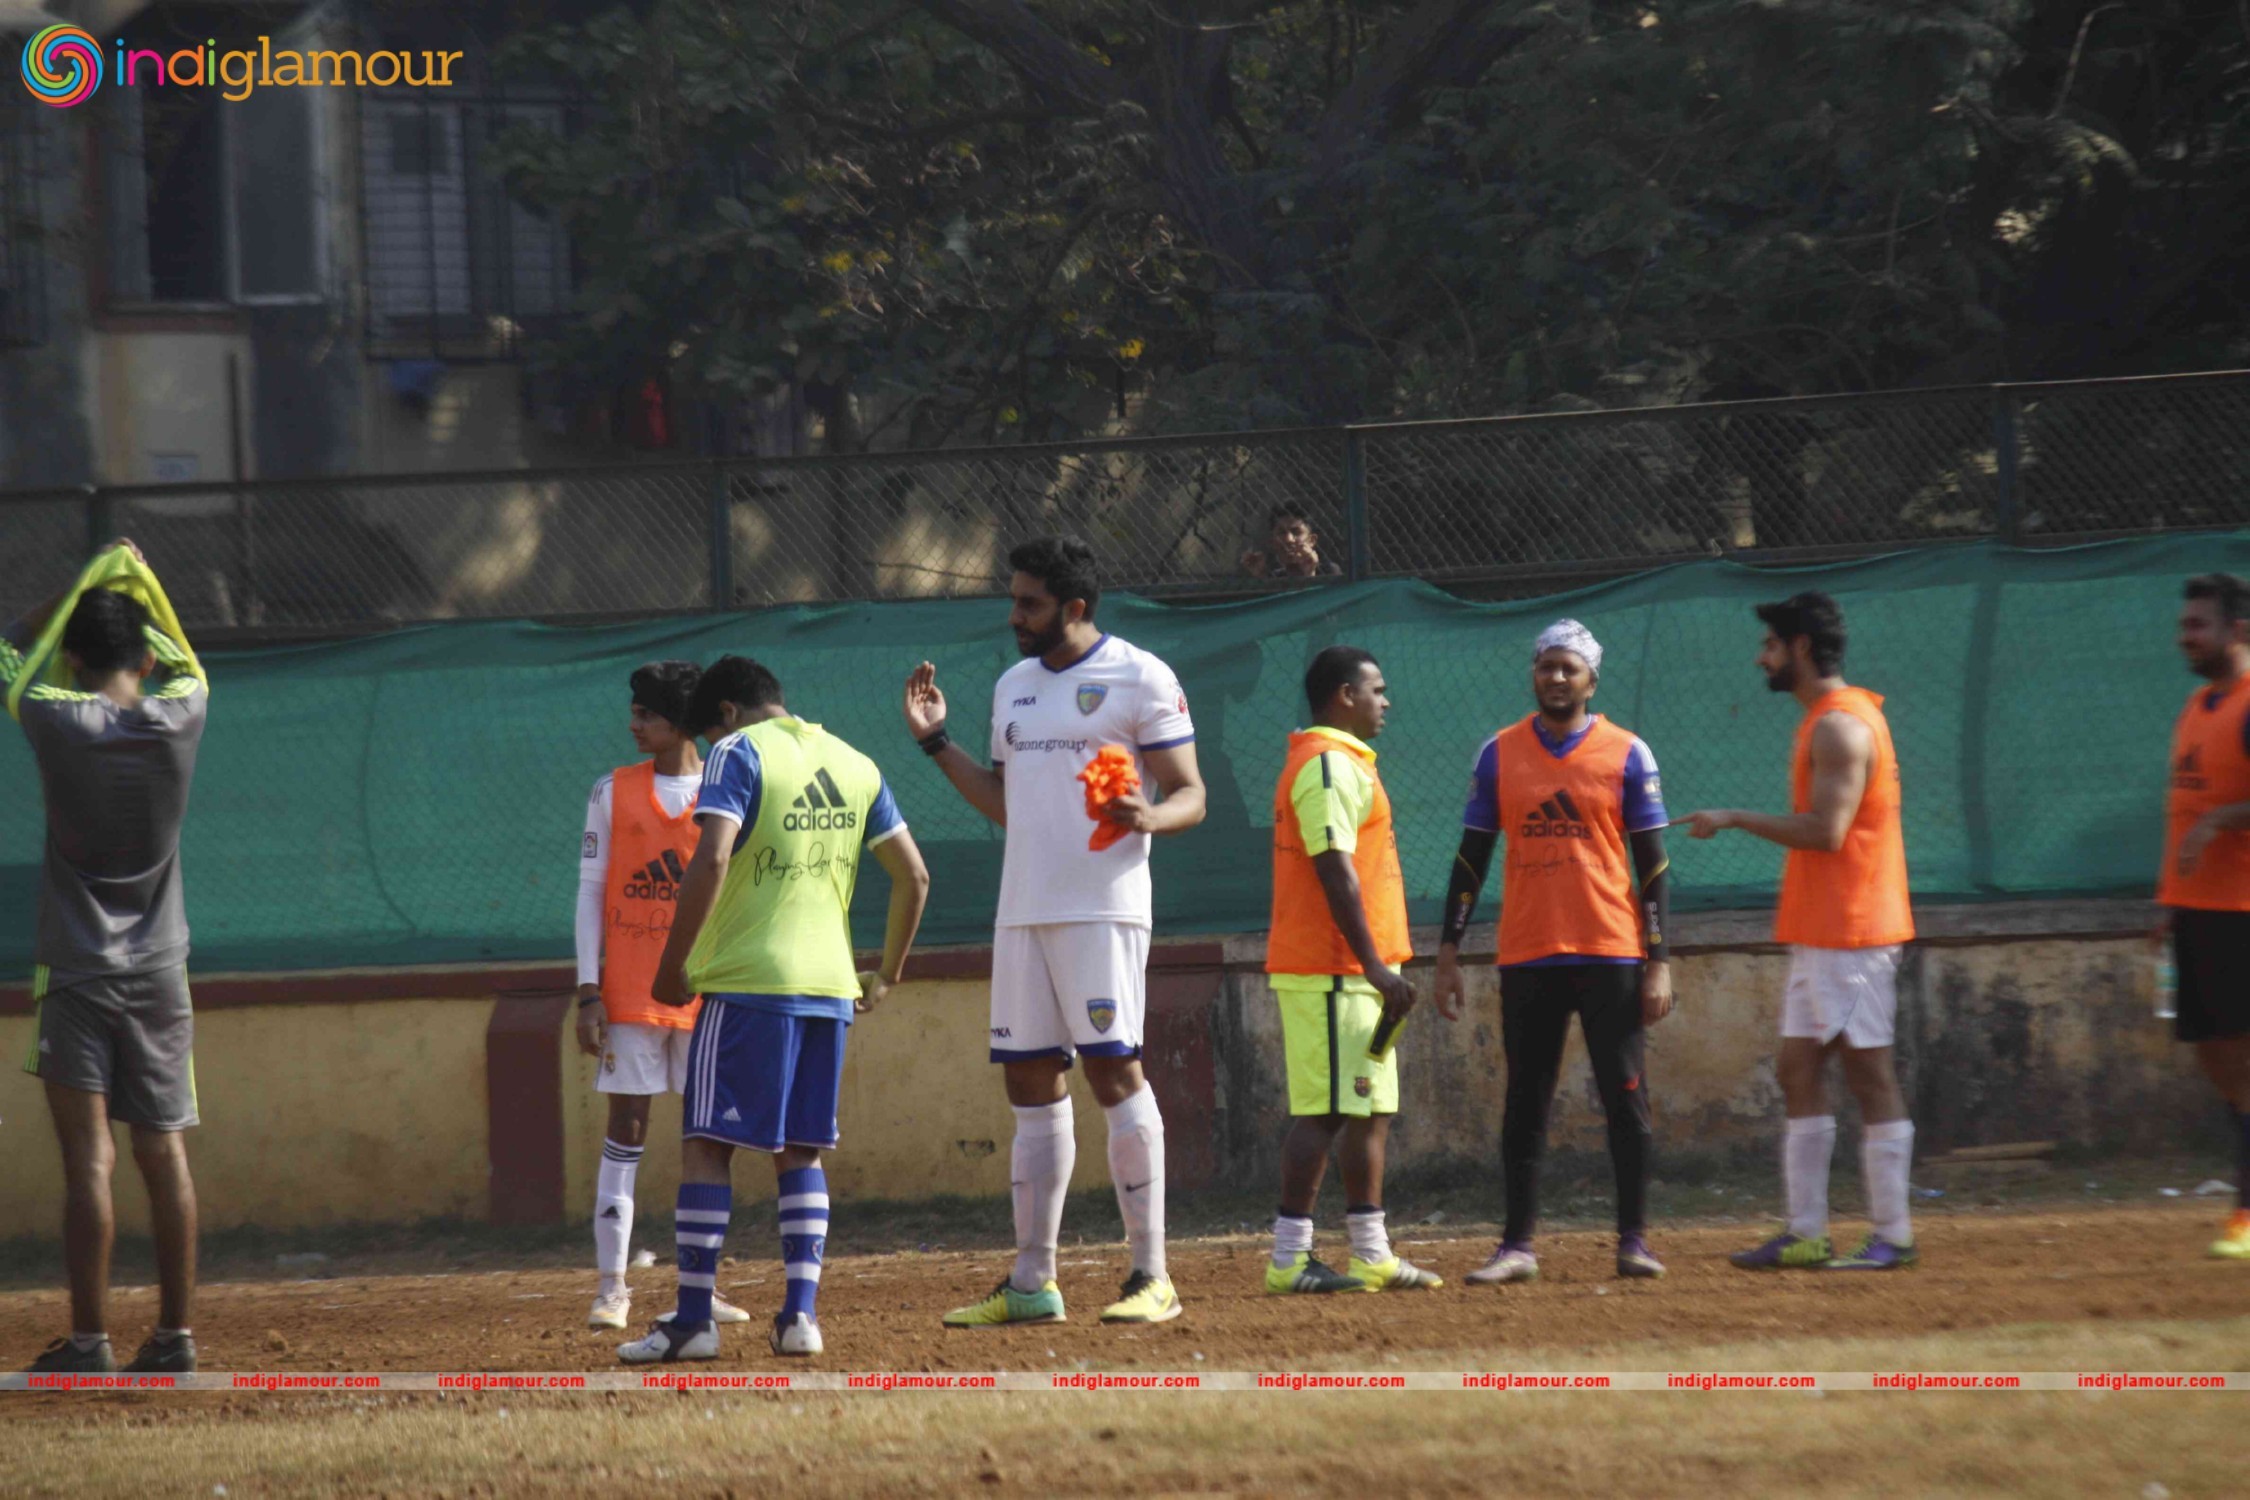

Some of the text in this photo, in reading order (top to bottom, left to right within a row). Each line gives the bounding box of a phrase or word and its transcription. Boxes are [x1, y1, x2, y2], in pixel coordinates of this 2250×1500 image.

[1012, 696, 1037, 708] TYKA
[783, 806, 857, 832] adidas
[1522, 820, 1593, 840] adidas
